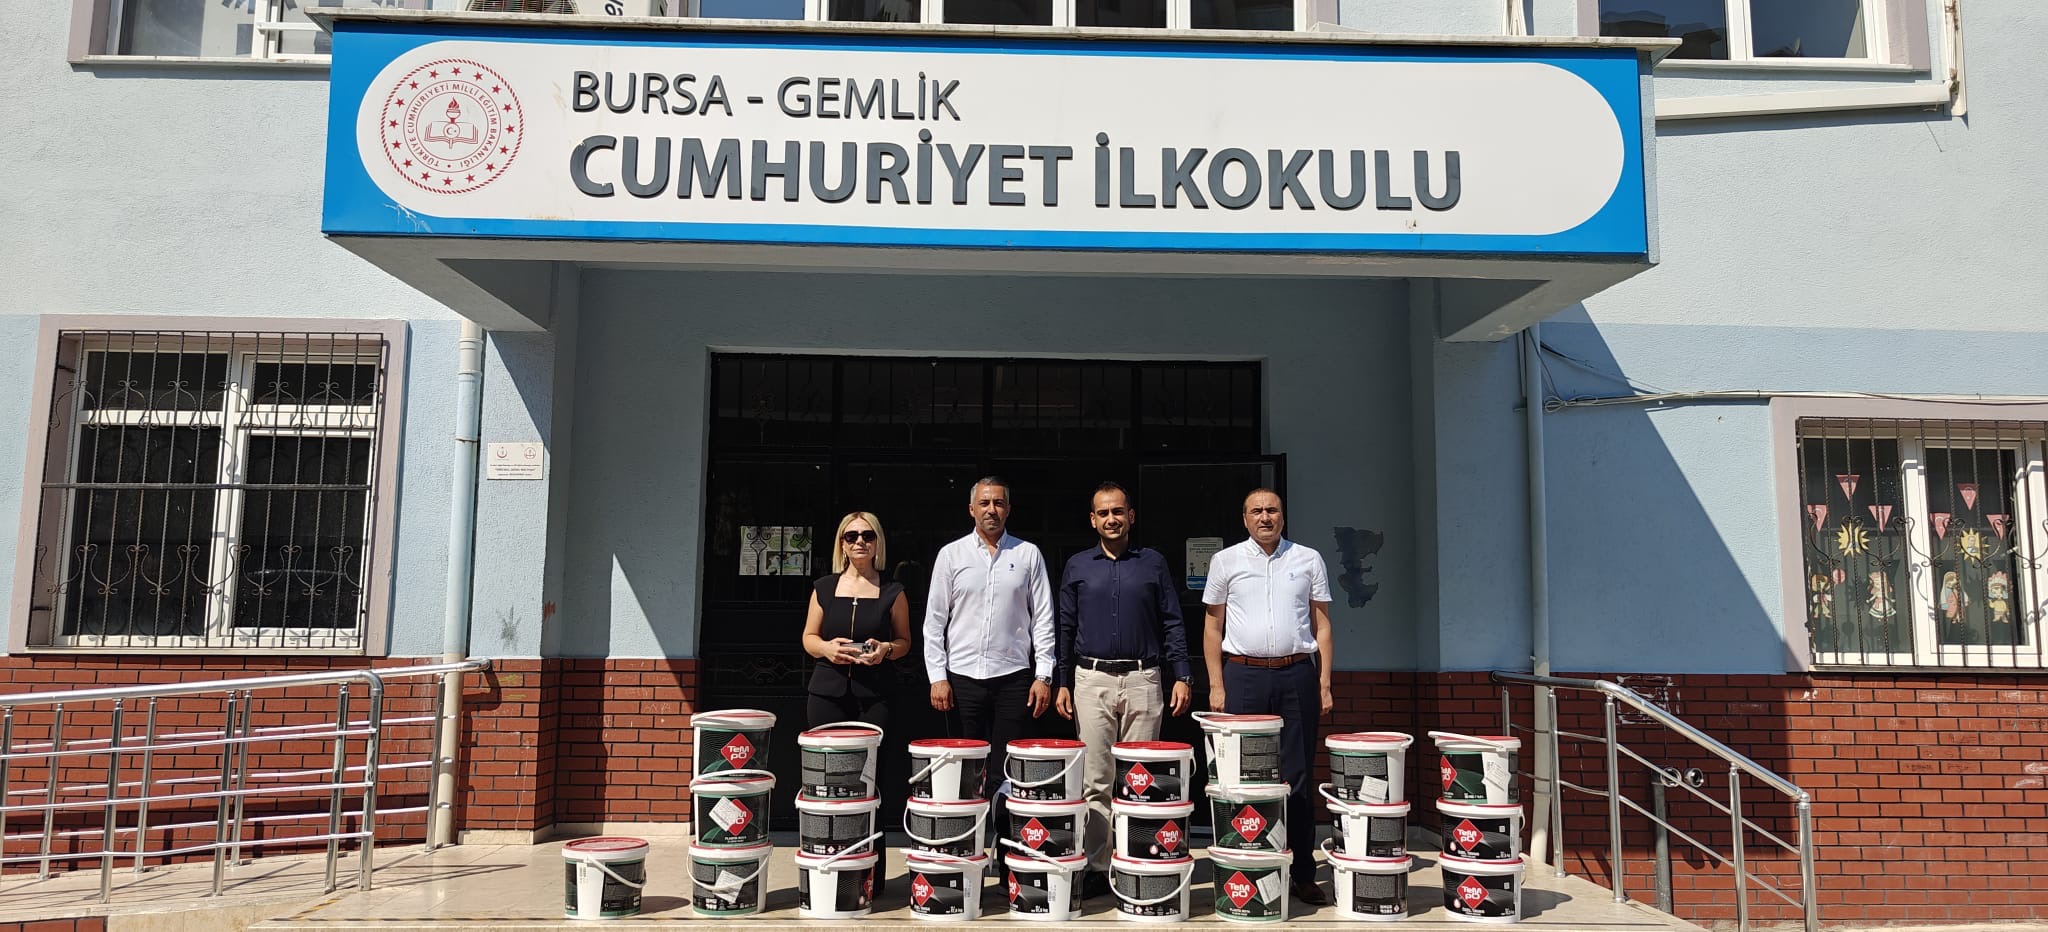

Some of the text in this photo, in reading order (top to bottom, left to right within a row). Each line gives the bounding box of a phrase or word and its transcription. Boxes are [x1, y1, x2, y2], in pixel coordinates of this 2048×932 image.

[573, 71, 732, 116] BURSA
[778, 72, 960, 121] GEMLİK
[570, 130, 1461, 211] CUMHURİYET İLKOKULU
